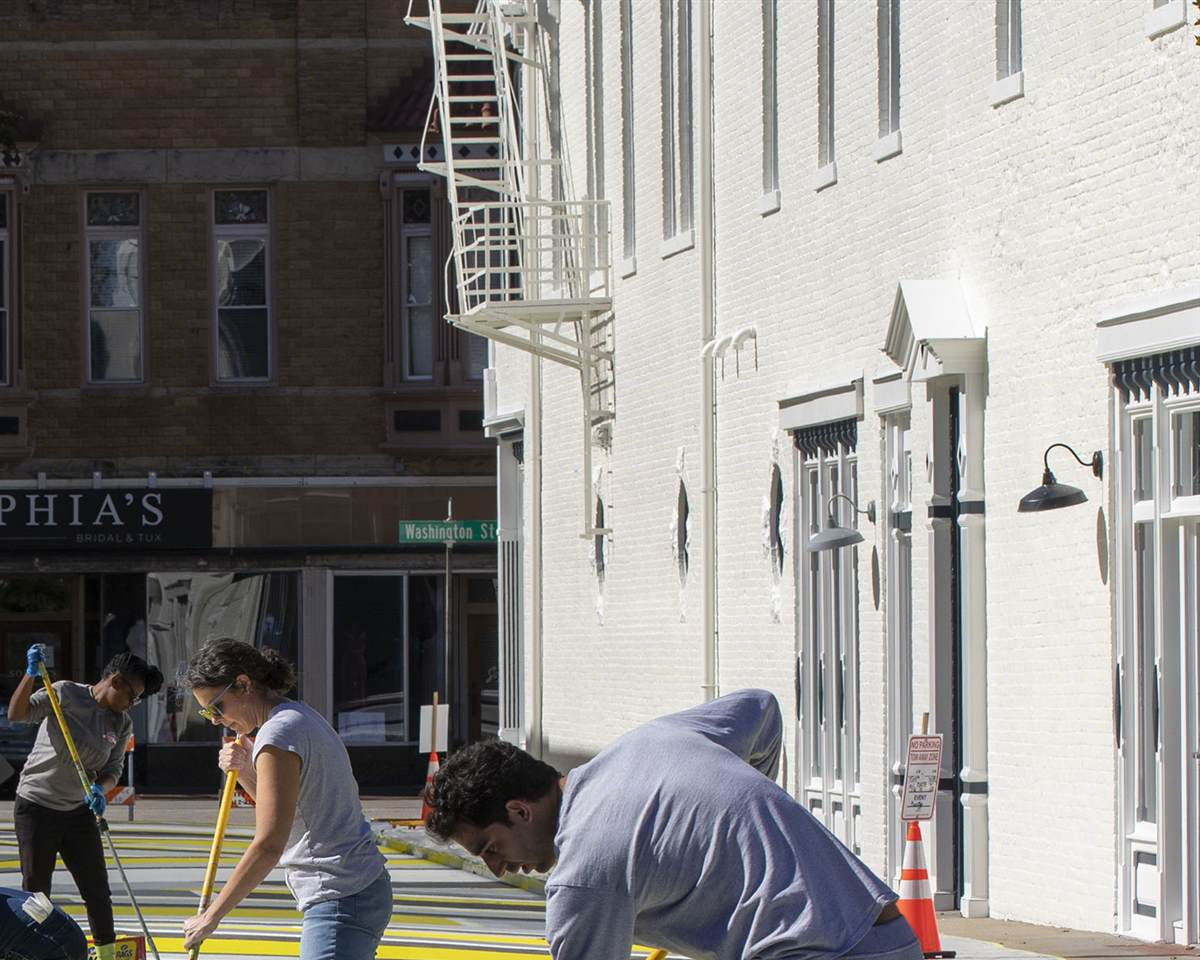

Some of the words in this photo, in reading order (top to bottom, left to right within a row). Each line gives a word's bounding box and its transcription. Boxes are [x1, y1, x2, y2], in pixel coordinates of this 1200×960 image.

[75, 534, 123, 544] BRIDAL
[126, 534, 134, 544] &
[137, 533, 162, 543] TUX
[404, 523, 473, 541] Washington
